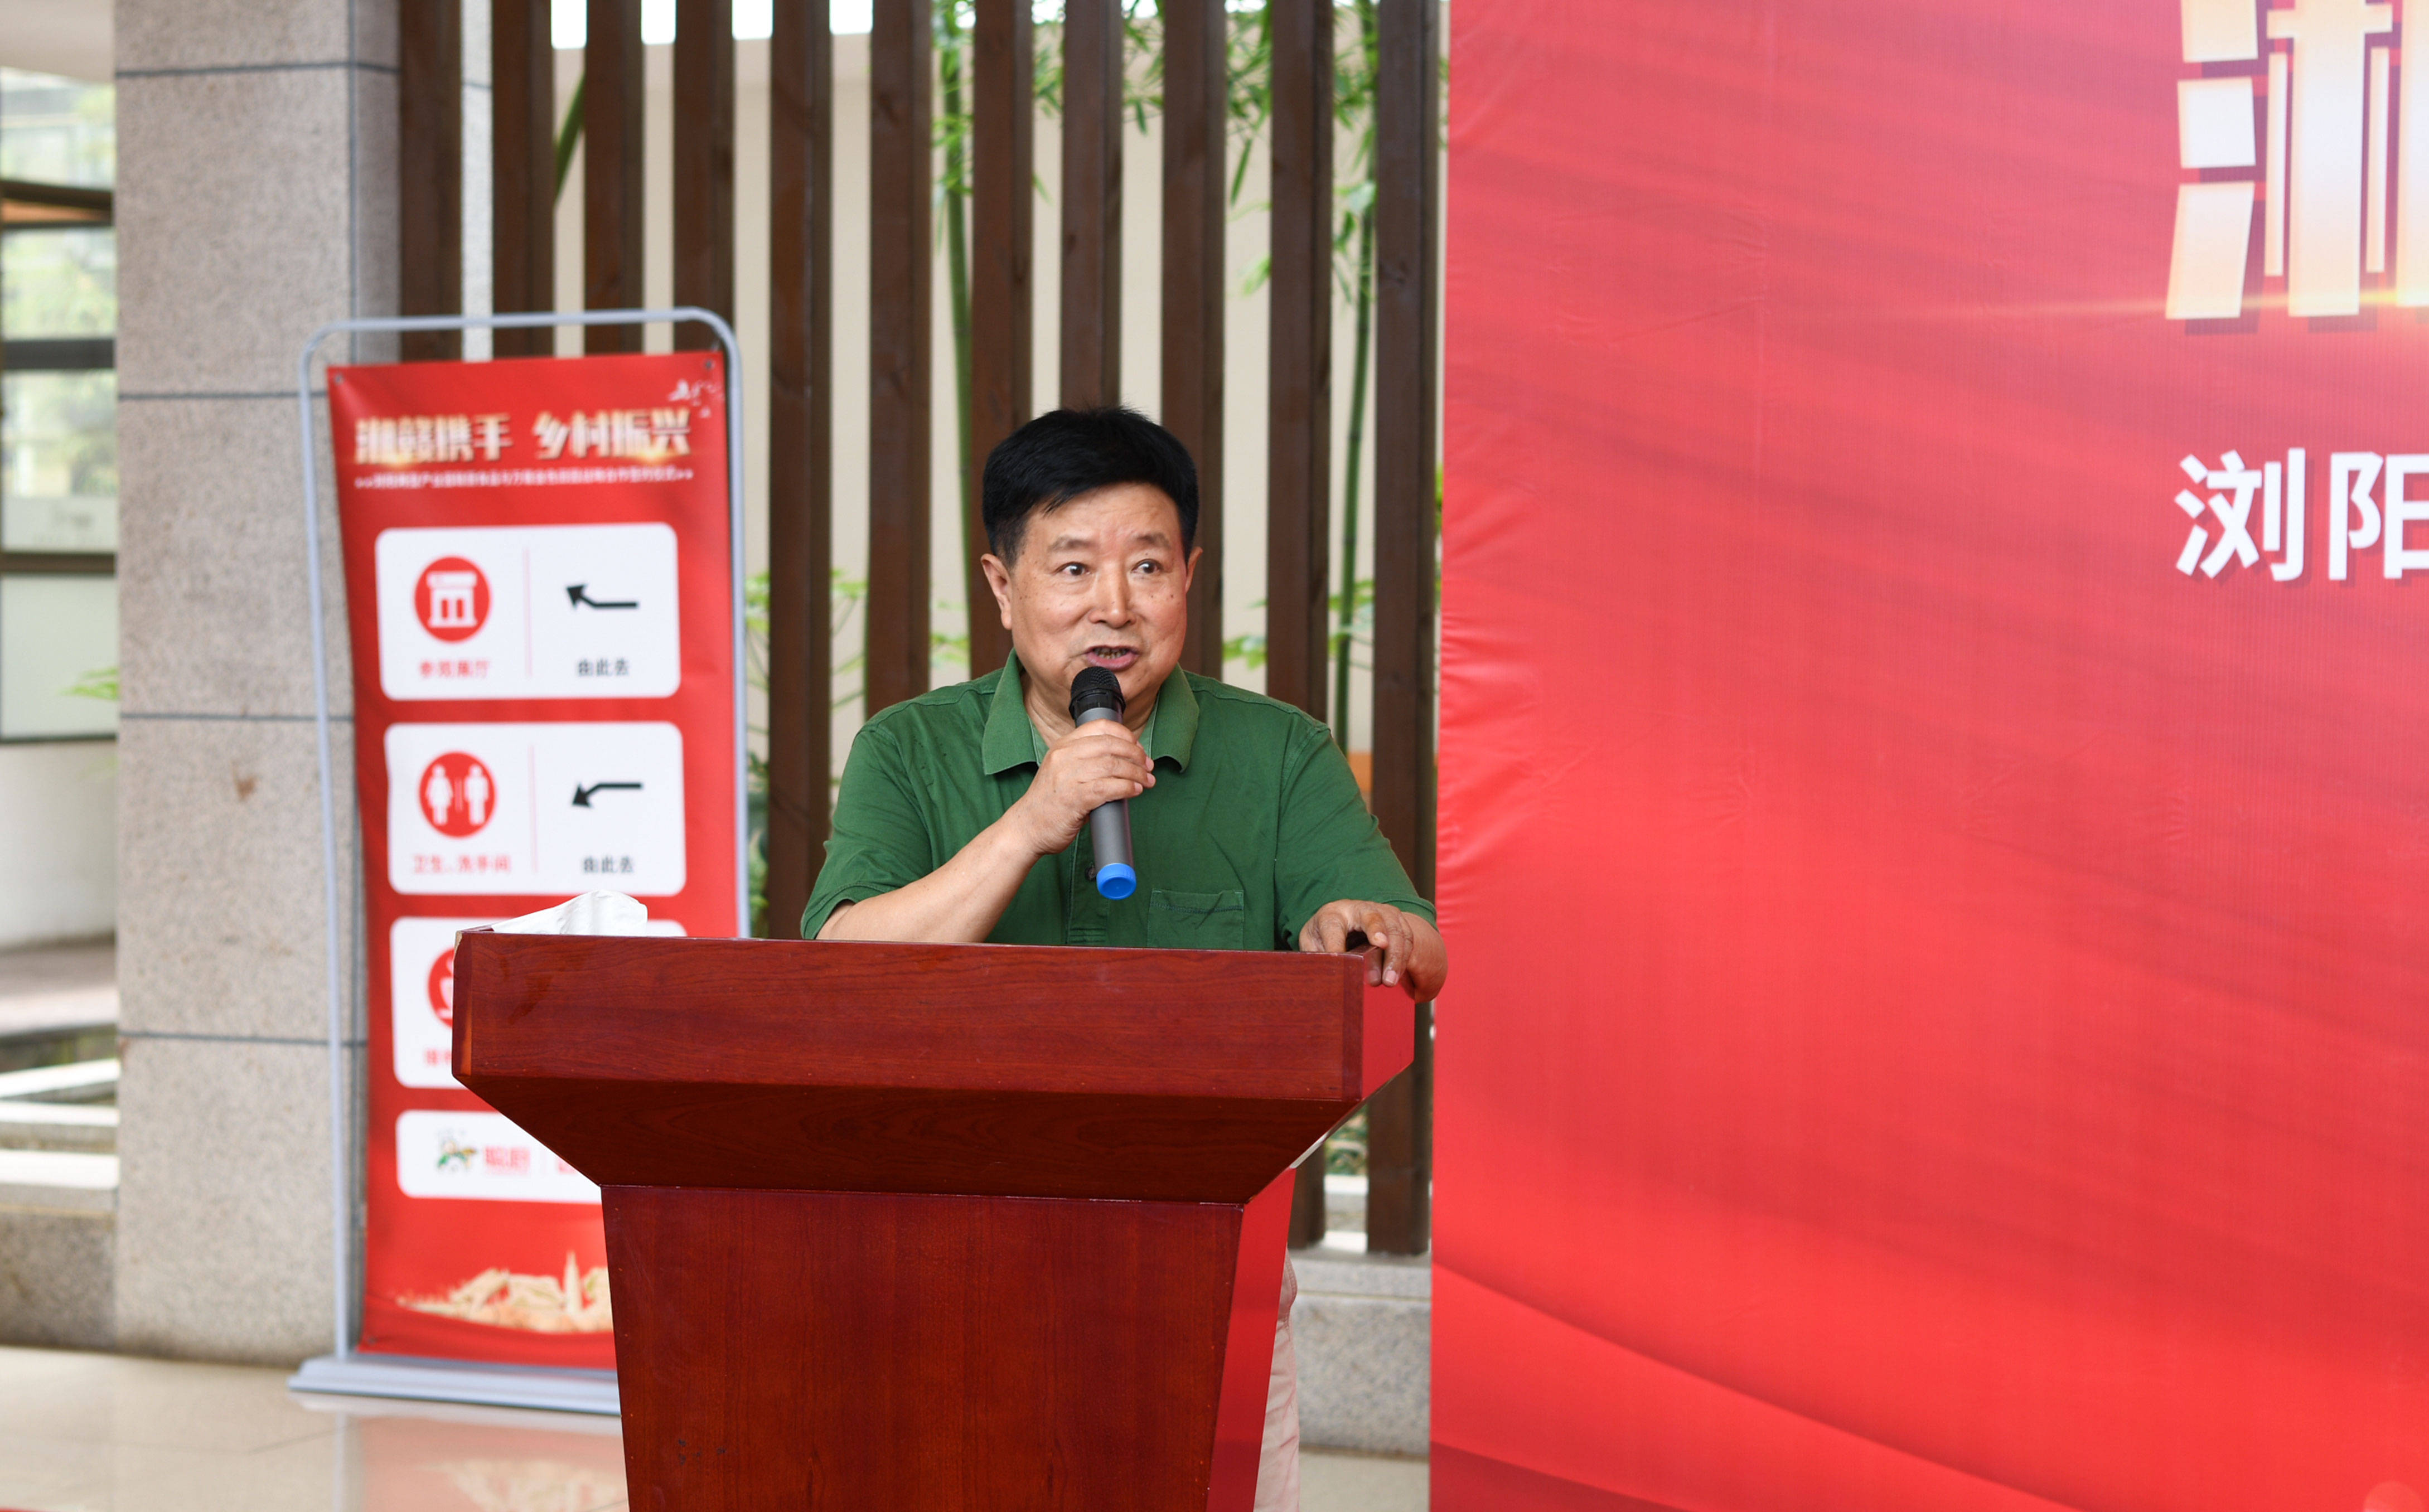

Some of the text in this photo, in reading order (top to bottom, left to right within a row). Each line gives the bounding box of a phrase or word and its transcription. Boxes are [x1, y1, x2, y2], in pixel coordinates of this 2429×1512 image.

[531, 407, 691, 459] 乡村振兴
[2175, 448, 2429, 581] 浏阳
[577, 658, 630, 677] 由此去
[581, 855, 635, 874] 由此去
